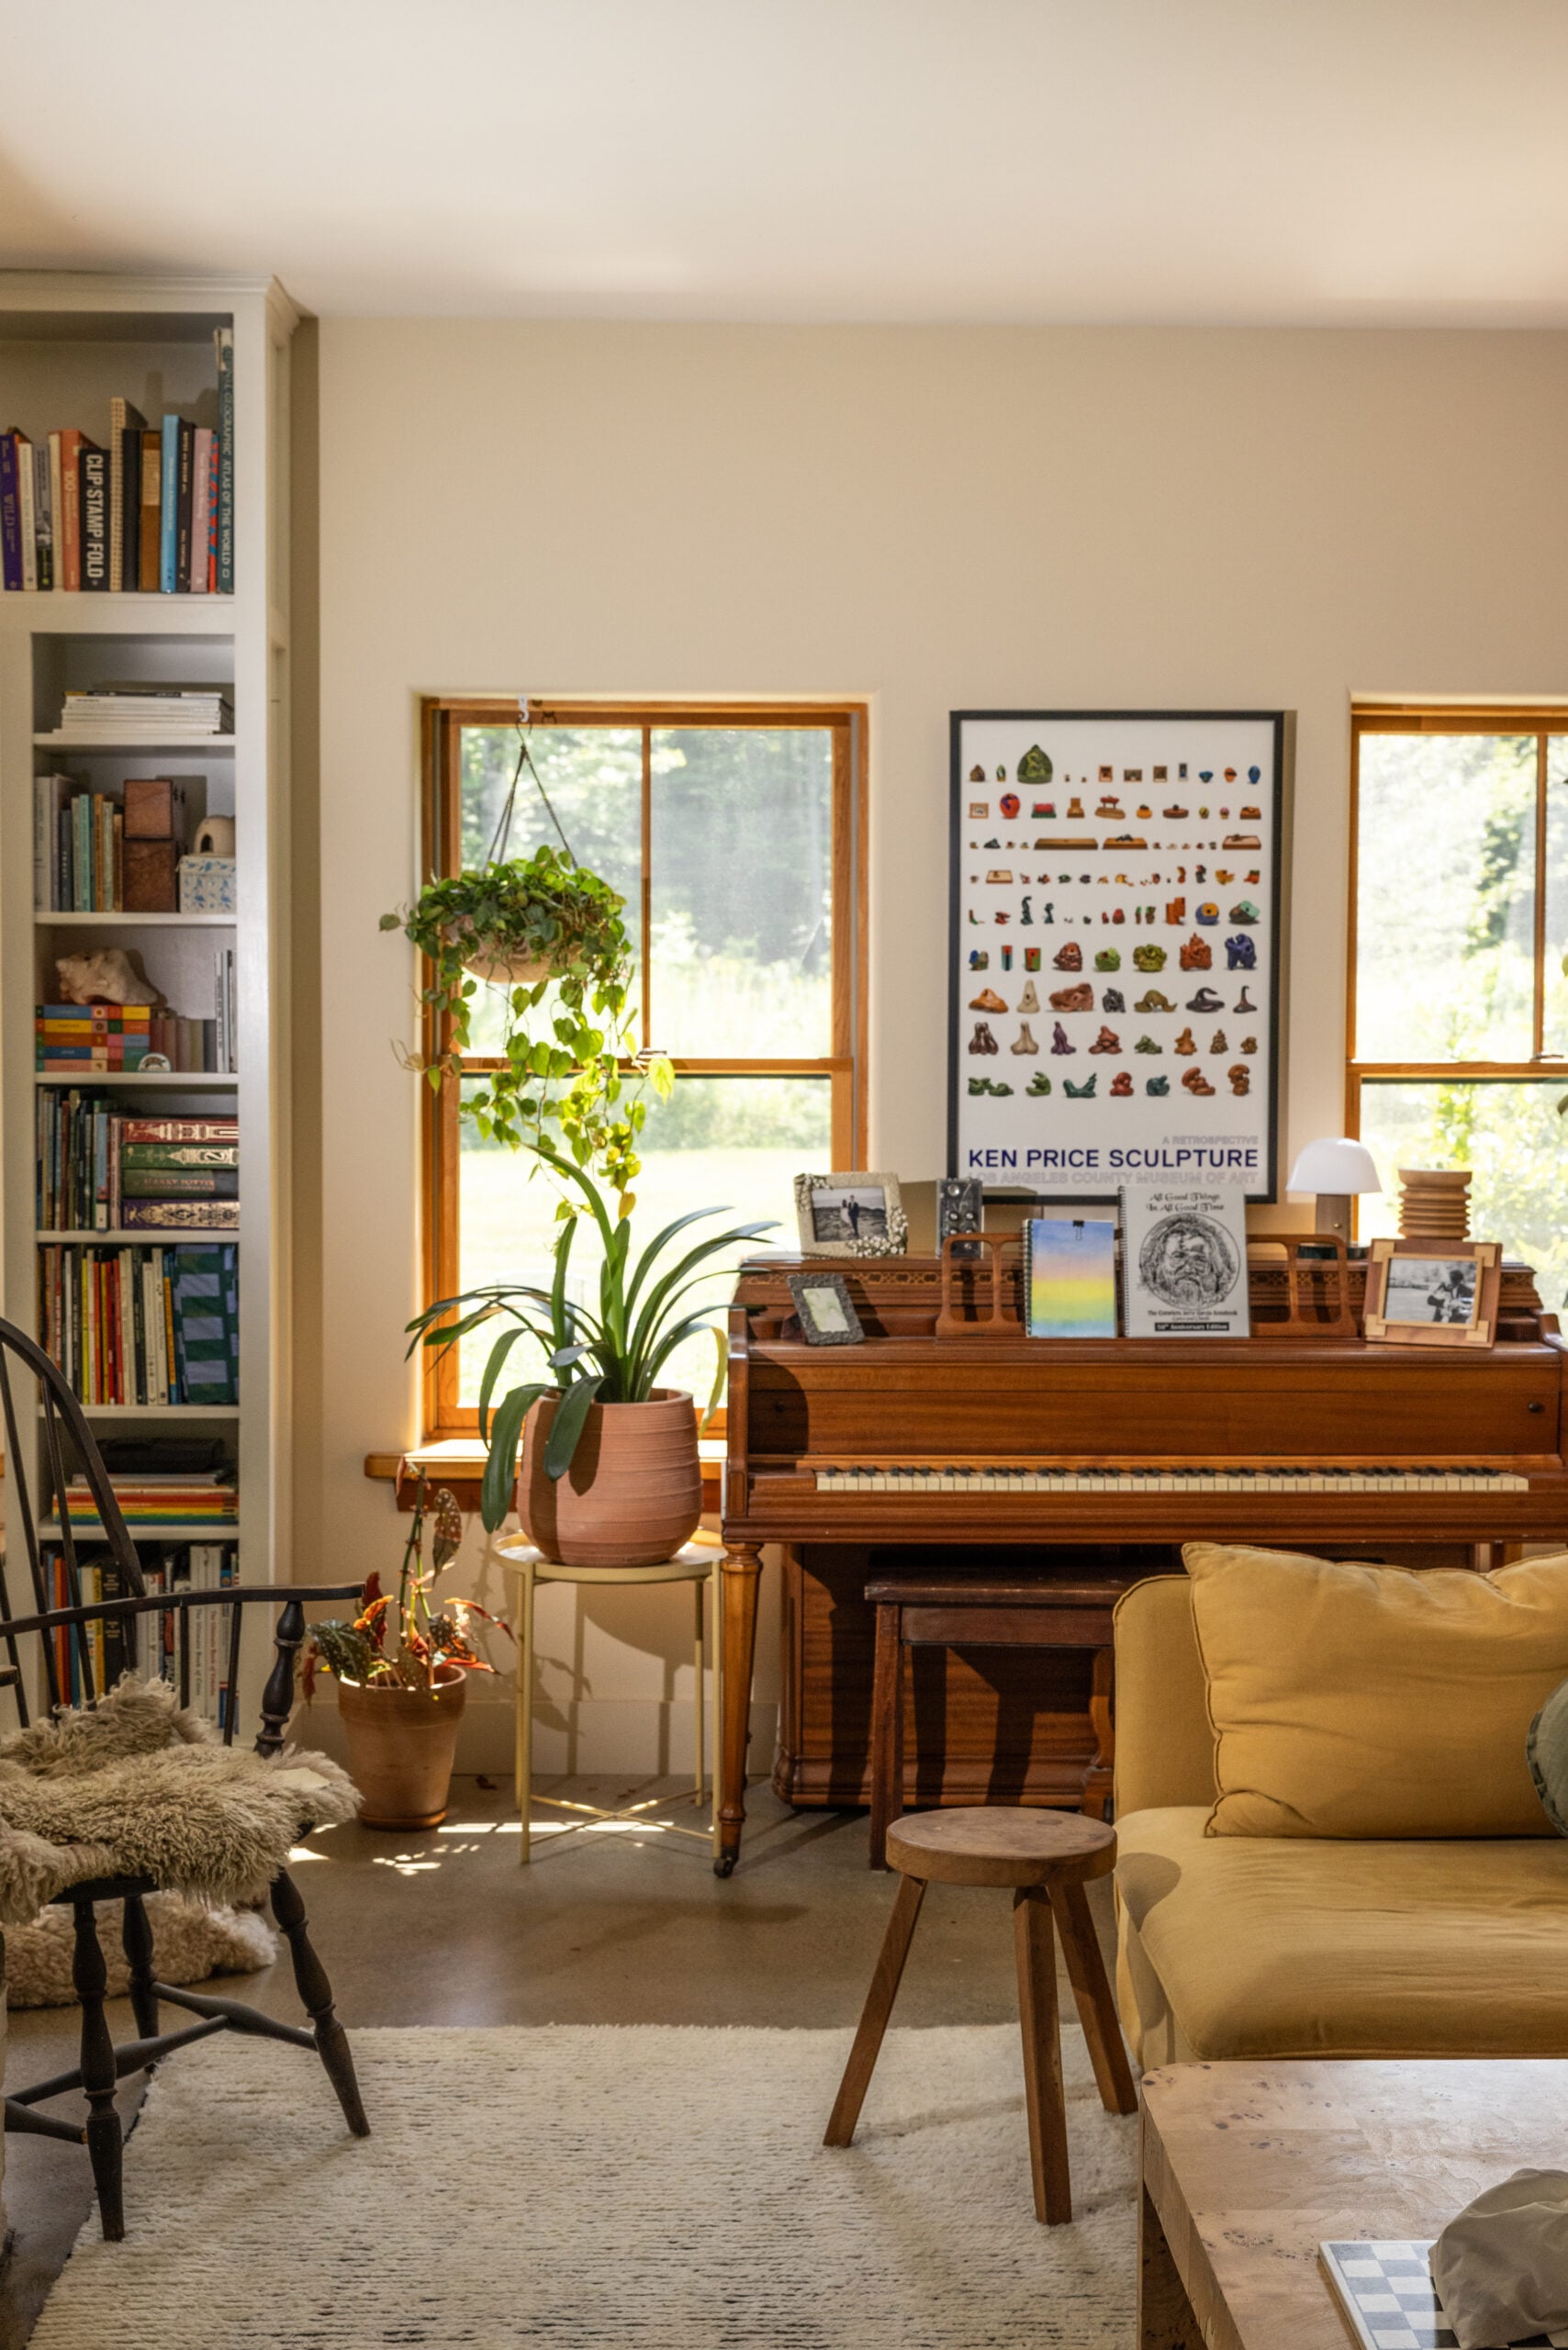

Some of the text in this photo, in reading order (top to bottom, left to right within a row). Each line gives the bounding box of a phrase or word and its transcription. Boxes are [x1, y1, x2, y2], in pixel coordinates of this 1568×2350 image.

[64, 469, 76, 491] 100
[222, 459, 230, 488] ATLAS
[87, 454, 103, 577] CLIP STAMP FOLD
[221, 529, 230, 565] WORLD
[1162, 1136, 1259, 1145] A RETROSPECTIVE
[969, 1149, 1258, 1168] KEN PRICE SCULPTURE
[969, 1171, 1257, 1184] OS ANGELES COUNTY MUSEUM OF ART
[1164, 1192, 1188, 1202] Good
[1175, 1203, 1198, 1212] Good
